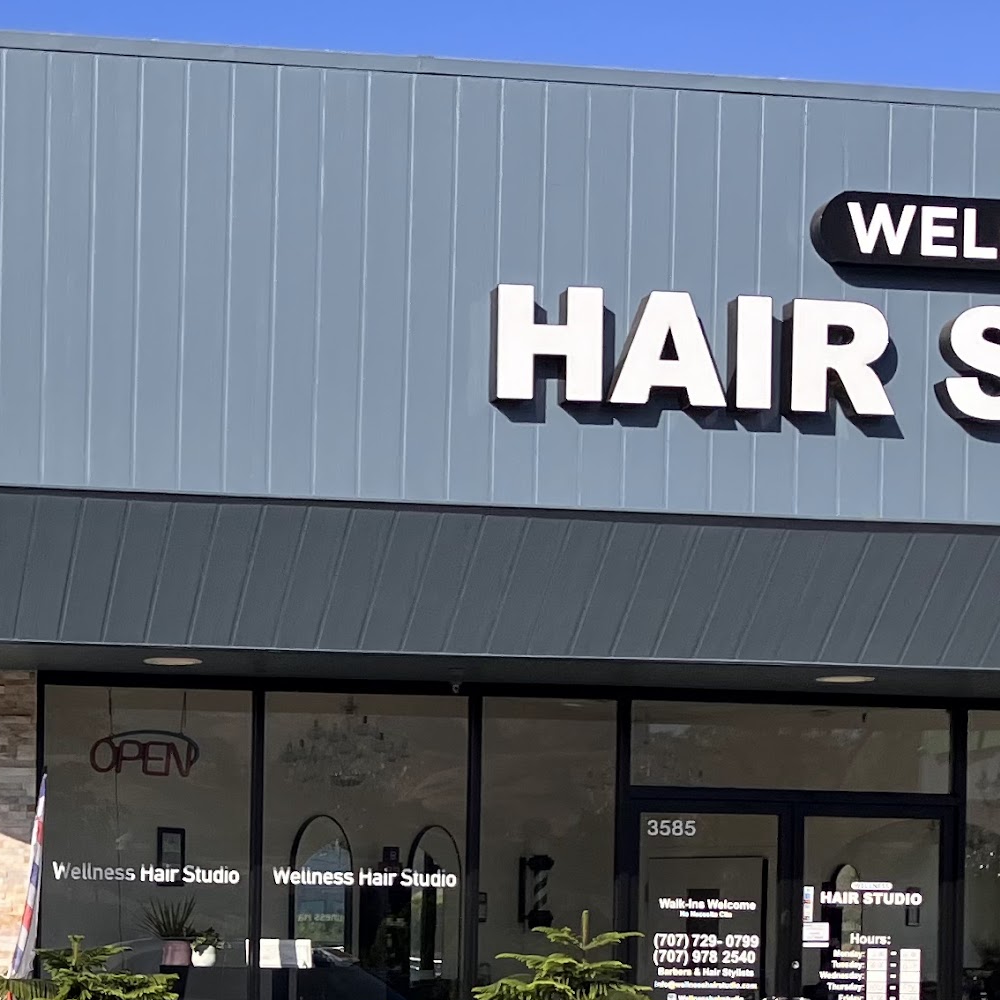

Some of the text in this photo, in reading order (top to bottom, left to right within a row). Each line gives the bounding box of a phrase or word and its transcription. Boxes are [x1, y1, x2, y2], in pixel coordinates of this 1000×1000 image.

[847, 202, 999, 260] WEL
[496, 284, 895, 416] HAIR
[90, 738, 194, 778] OPEN
[647, 819, 696, 836] 3585
[52, 861, 240, 884] Wellness Hair Studio
[273, 866, 457, 888] Wellness Hair Studio
[707, 898, 757, 911] Welcome
[820, 891, 859, 905] HAIR
[863, 892, 923, 906] STUDIO
[653, 933, 760, 950] (707) 729- 0799
[850, 932, 891, 945] Hours:
[653, 949, 756, 966] (707) 978 2540
[693, 967, 701, 976] &
[702, 967, 721, 977] Hair
